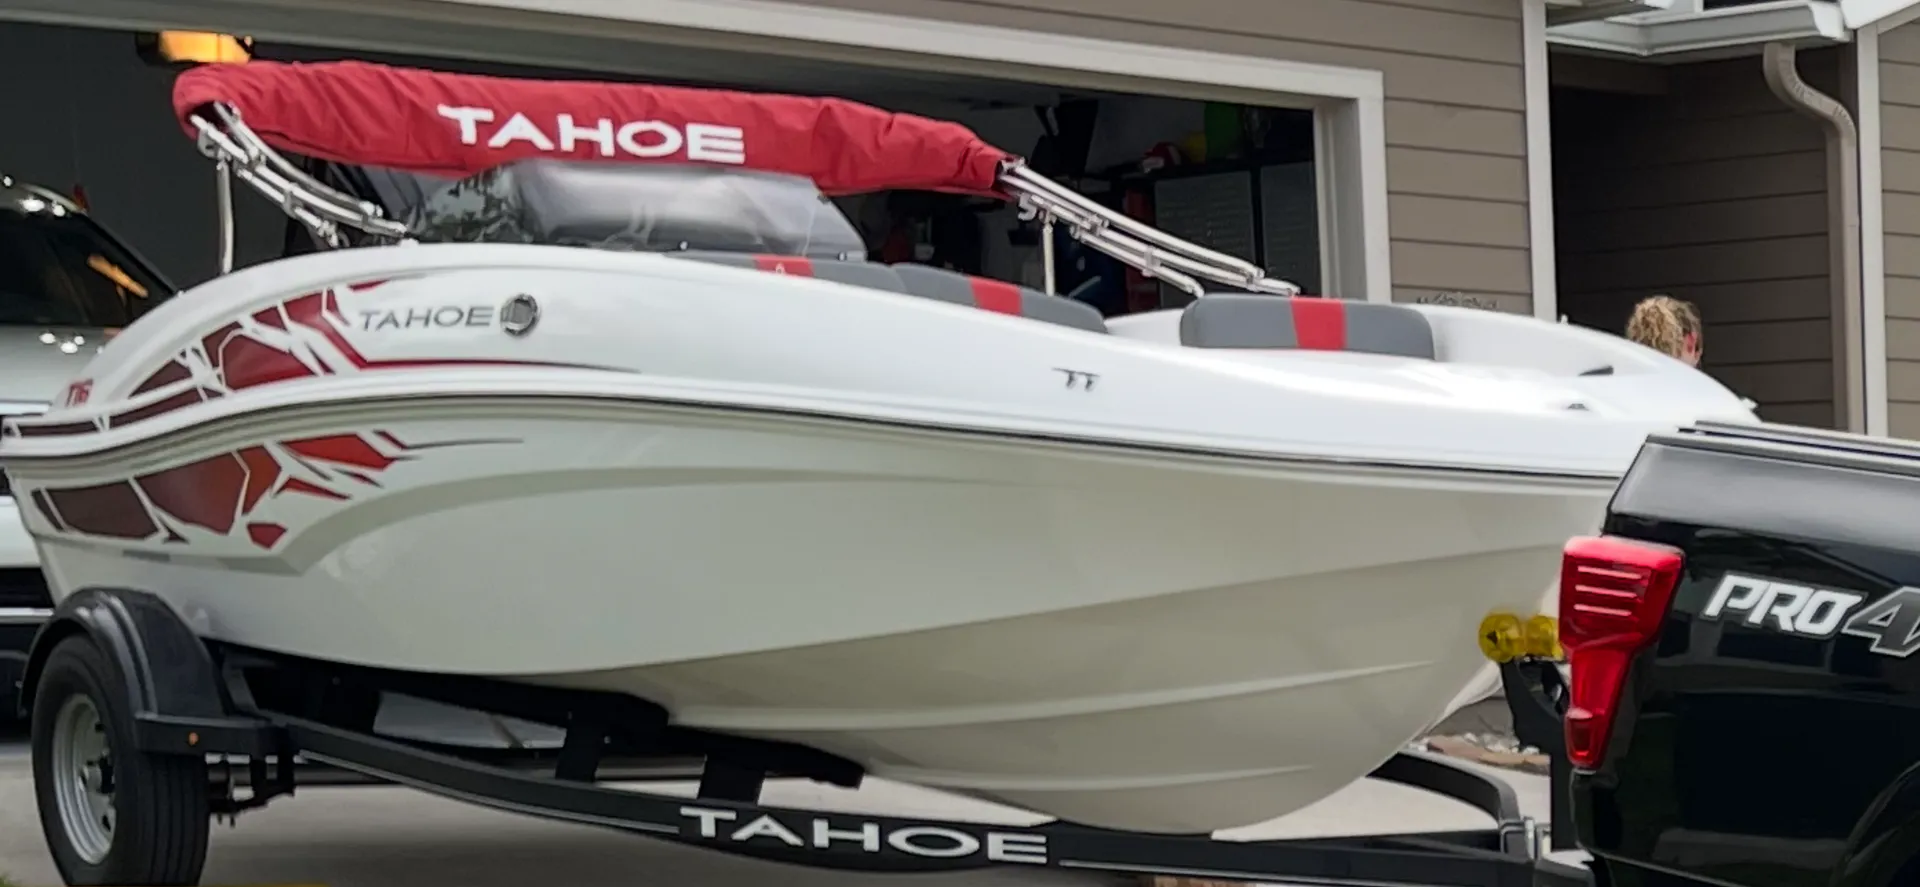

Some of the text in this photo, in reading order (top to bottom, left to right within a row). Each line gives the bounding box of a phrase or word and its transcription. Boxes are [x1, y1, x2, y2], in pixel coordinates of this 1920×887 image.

[437, 104, 745, 164] TAHOE
[359, 306, 494, 331] TAHOE
[680, 806, 1047, 864] TAHOE
